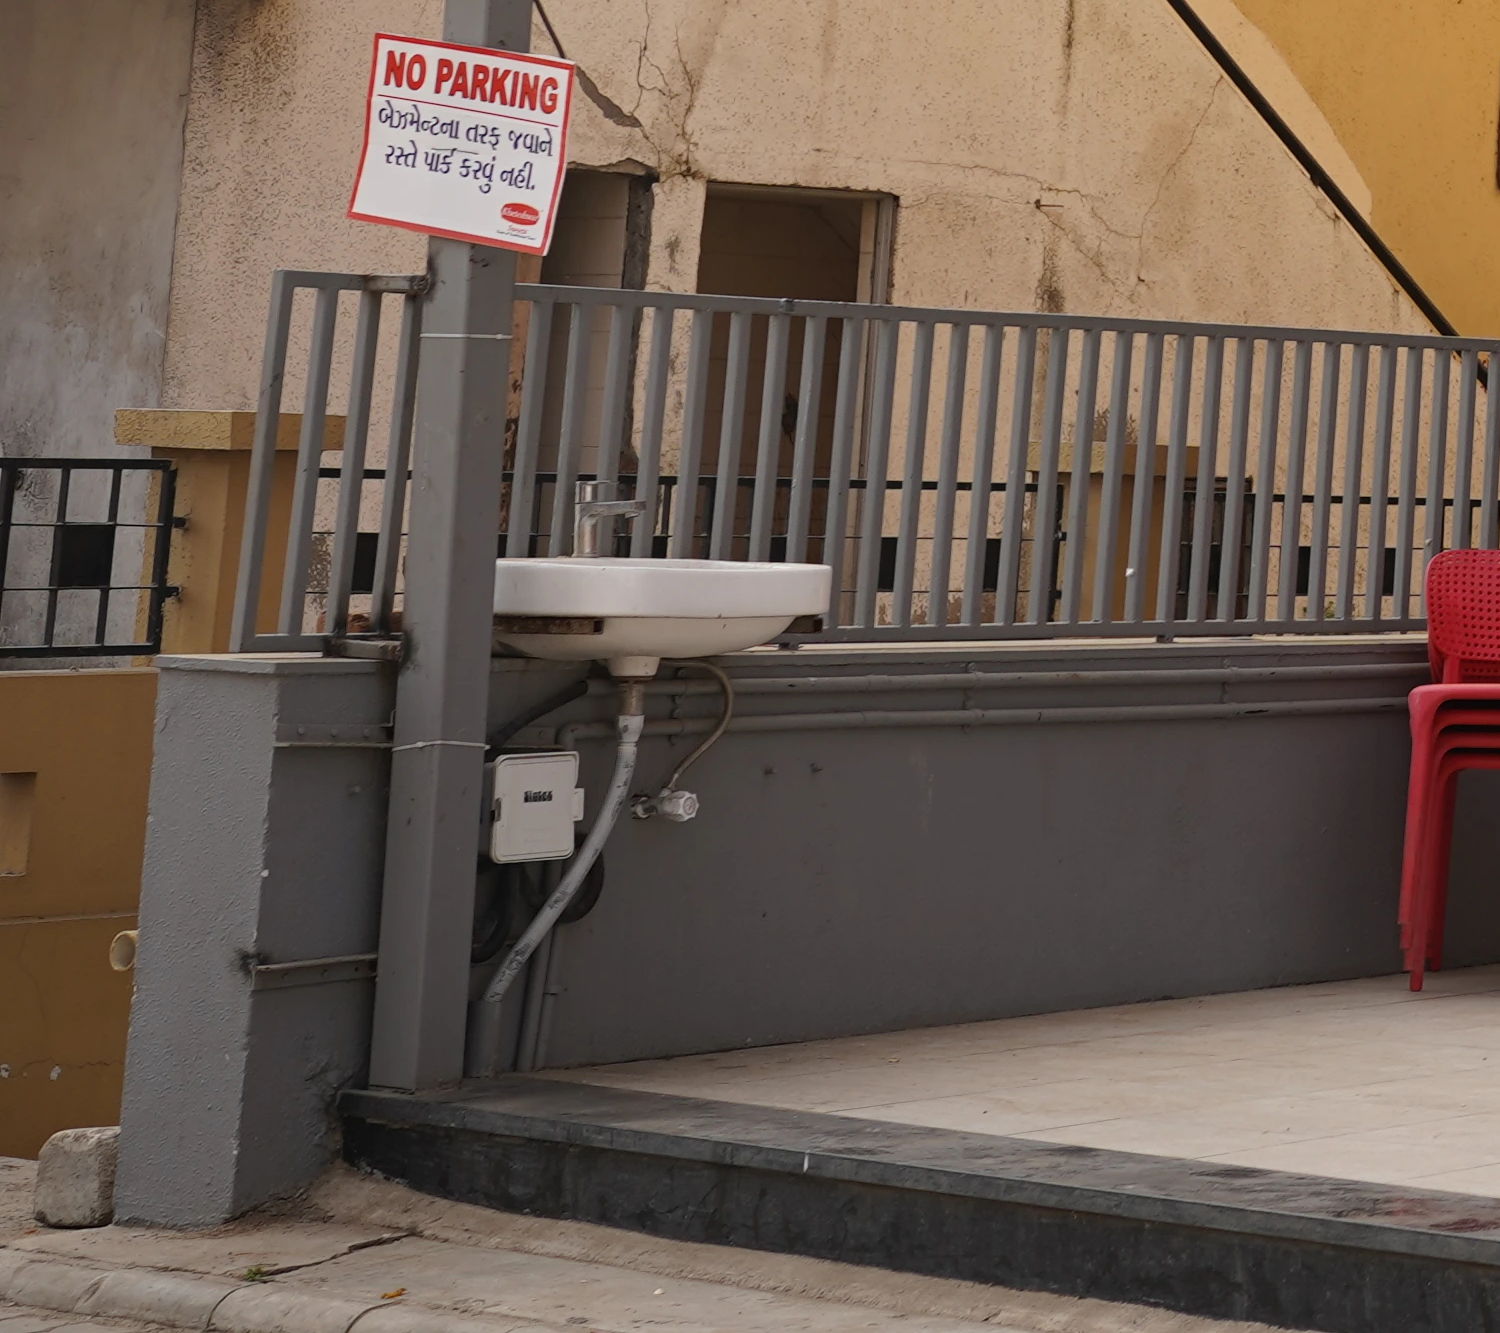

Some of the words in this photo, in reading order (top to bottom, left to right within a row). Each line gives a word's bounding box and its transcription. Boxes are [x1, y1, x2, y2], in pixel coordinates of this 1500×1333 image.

[383, 50, 427, 91] NO
[434, 58, 559, 114] PARKING
[385, 140, 418, 168] રસ્તે
[466, 123, 500, 150] તરફ
[508, 128, 553, 156] જવાને
